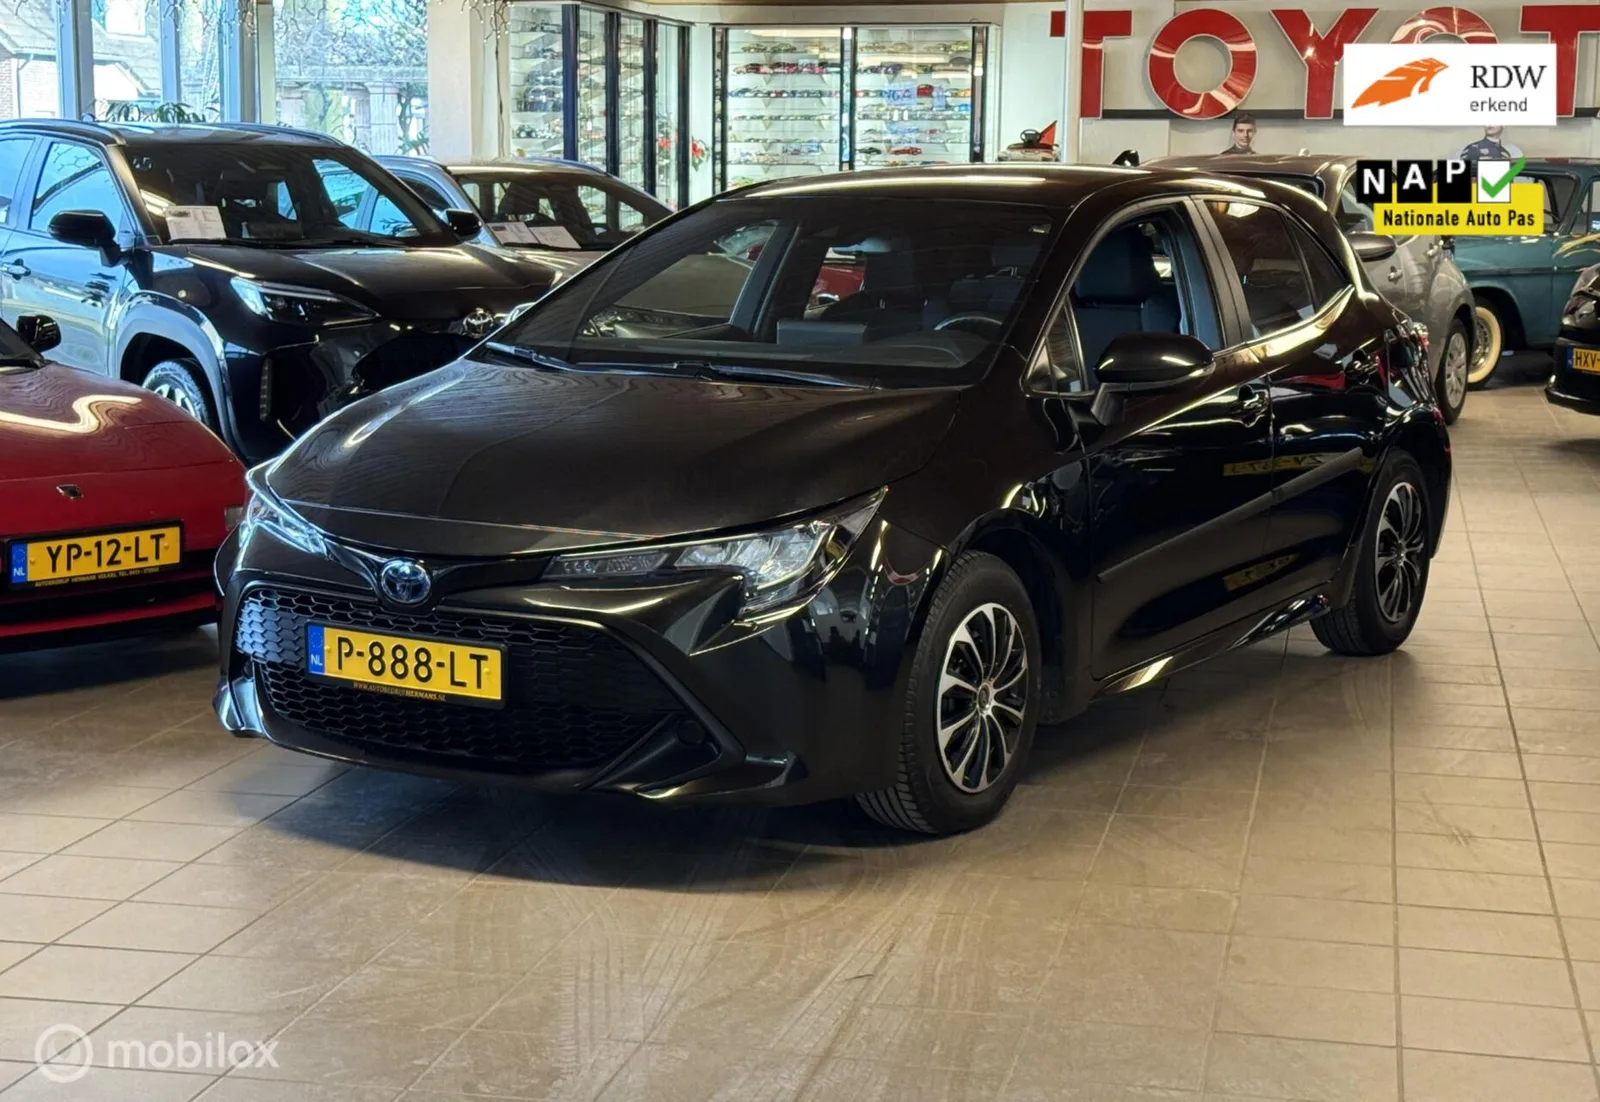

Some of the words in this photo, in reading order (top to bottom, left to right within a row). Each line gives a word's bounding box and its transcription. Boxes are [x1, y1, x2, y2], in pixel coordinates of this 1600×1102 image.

[46, 532, 166, 574] YP-12-LT
[13, 566, 26, 577] NL
[310, 653, 323, 667] NL
[337, 636, 489, 689] P-888-LT
